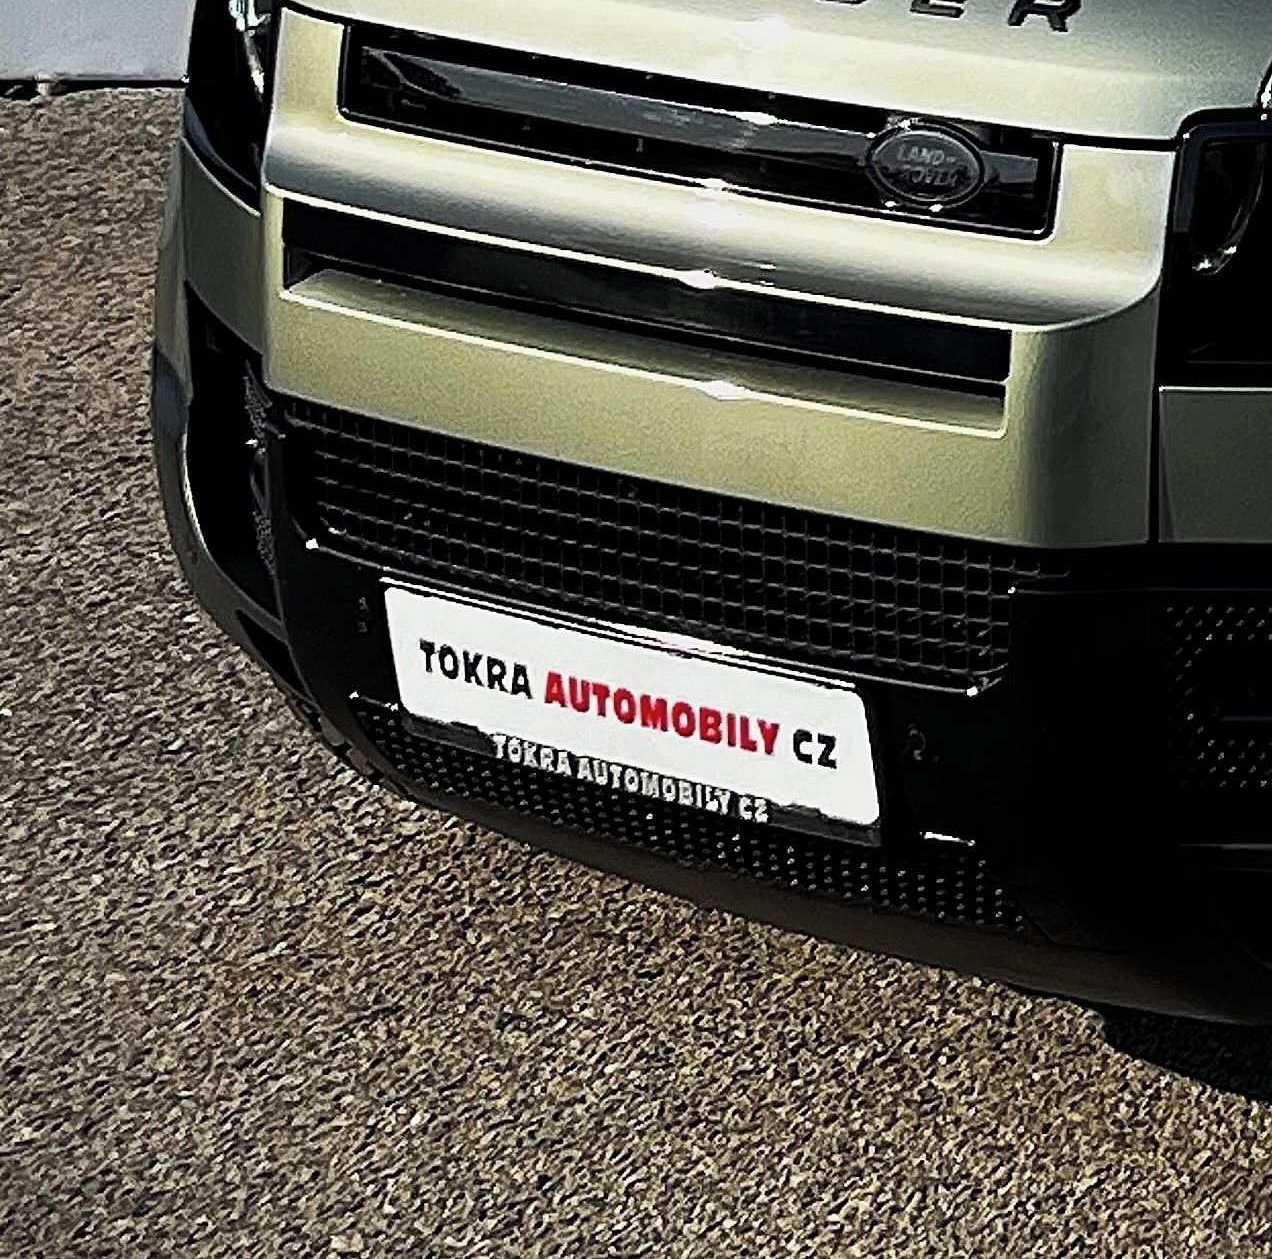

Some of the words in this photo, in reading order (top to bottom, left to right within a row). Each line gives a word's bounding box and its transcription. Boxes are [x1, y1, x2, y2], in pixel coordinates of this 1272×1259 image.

[418, 638, 534, 700] TOKRA
[543, 670, 780, 755] AUTOMOBILY
[792, 728, 838, 770] CZ
[493, 734, 572, 777] TOKRA
[577, 756, 731, 815] AUTOMOBILY
[738, 796, 770, 823] CZ
